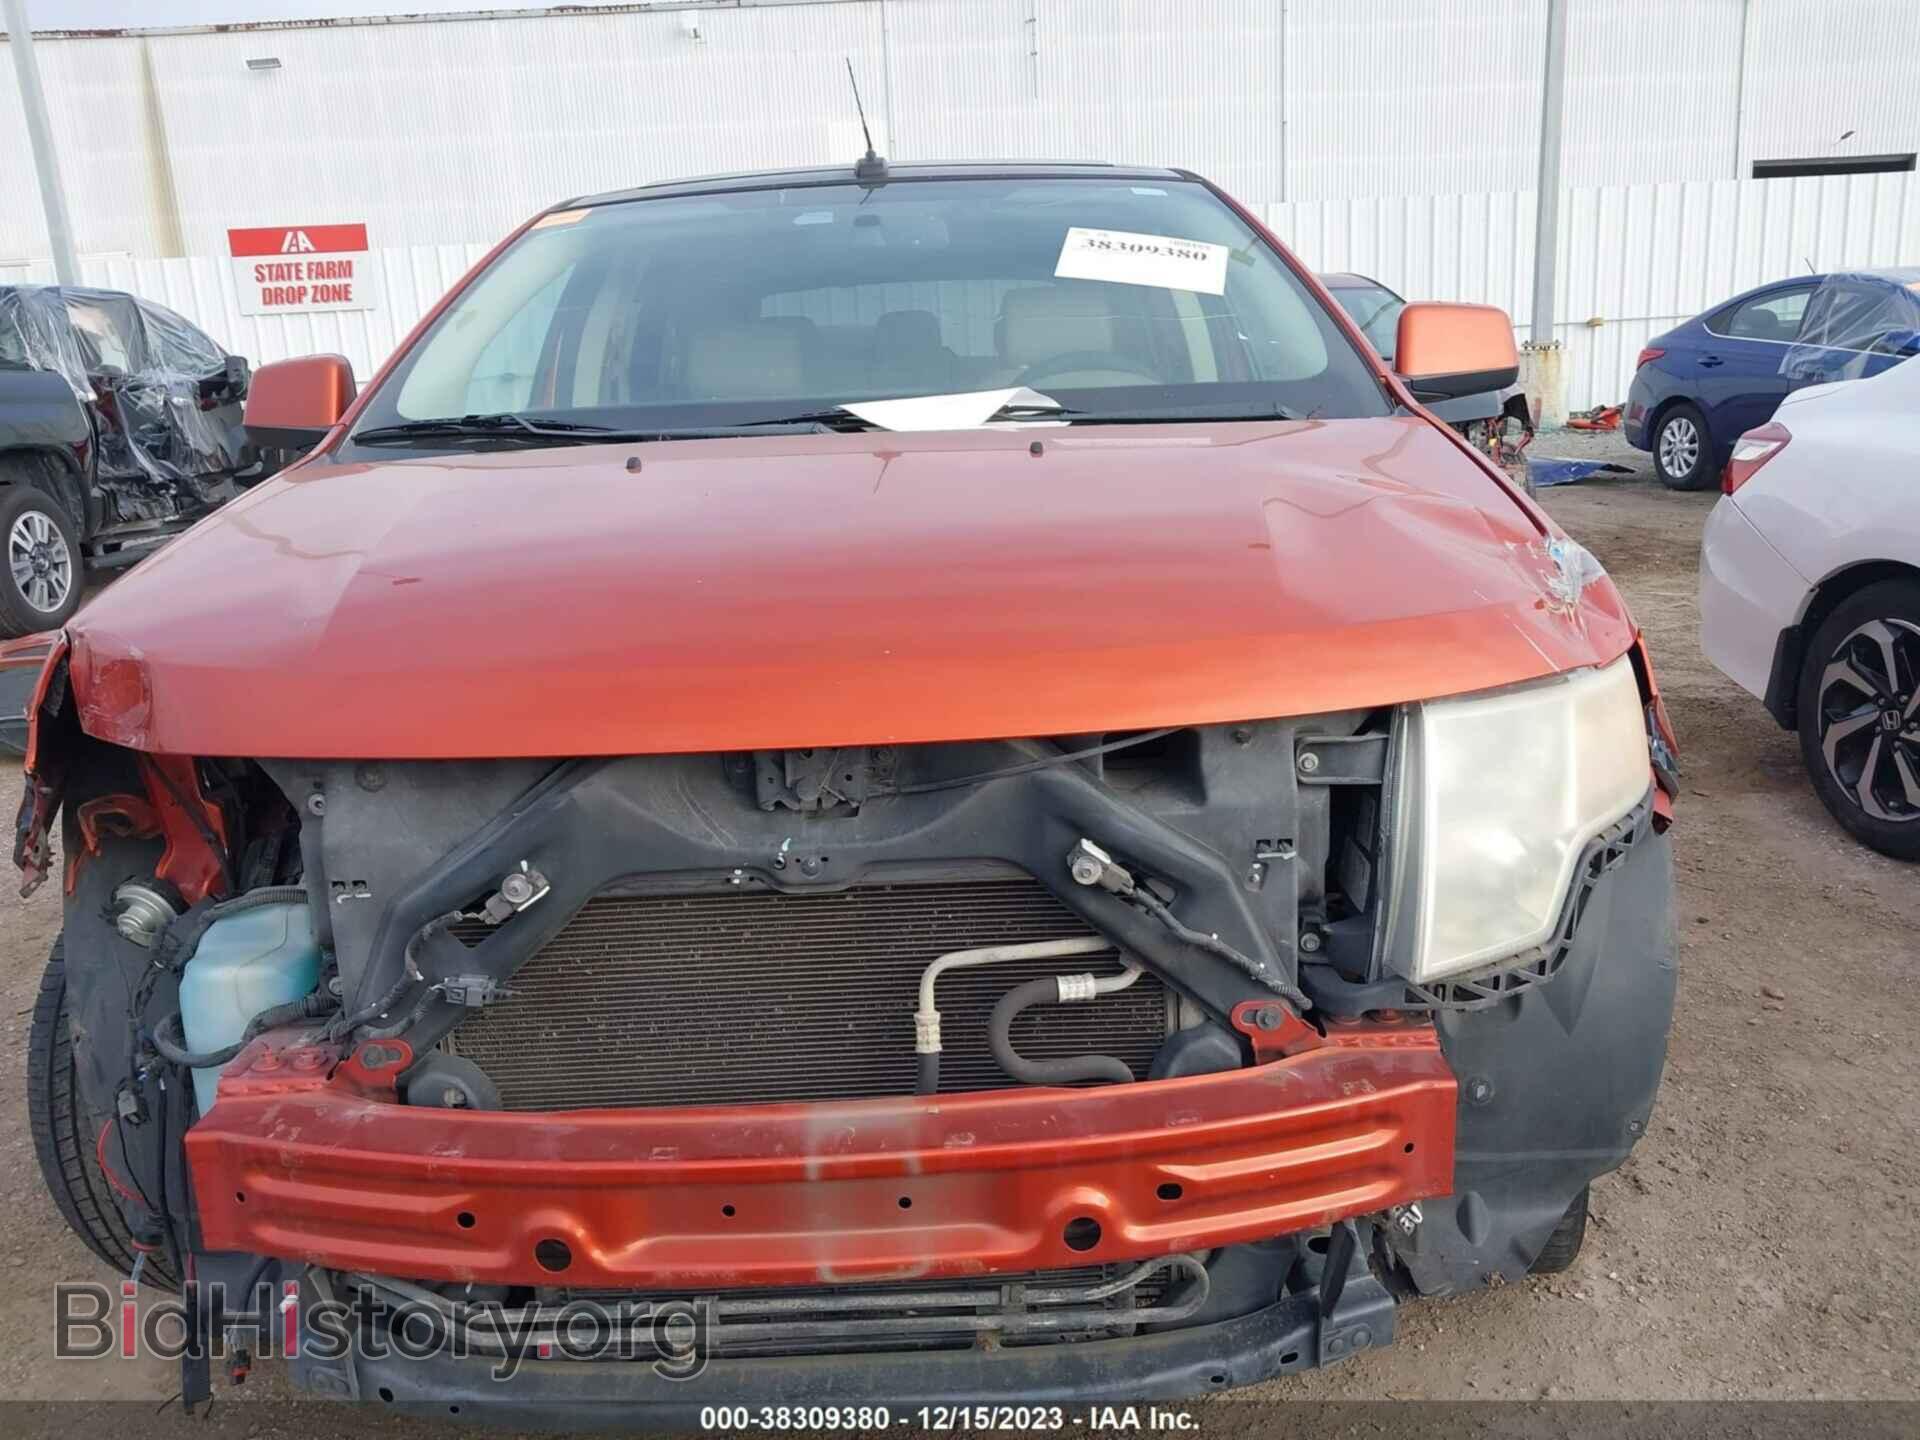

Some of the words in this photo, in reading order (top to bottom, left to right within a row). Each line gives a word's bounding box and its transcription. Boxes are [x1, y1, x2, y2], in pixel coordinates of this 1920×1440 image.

[254, 262, 304, 283] STATE
[306, 260, 353, 280] FARM
[262, 285, 307, 306] DROP
[310, 283, 353, 304] ZONE
